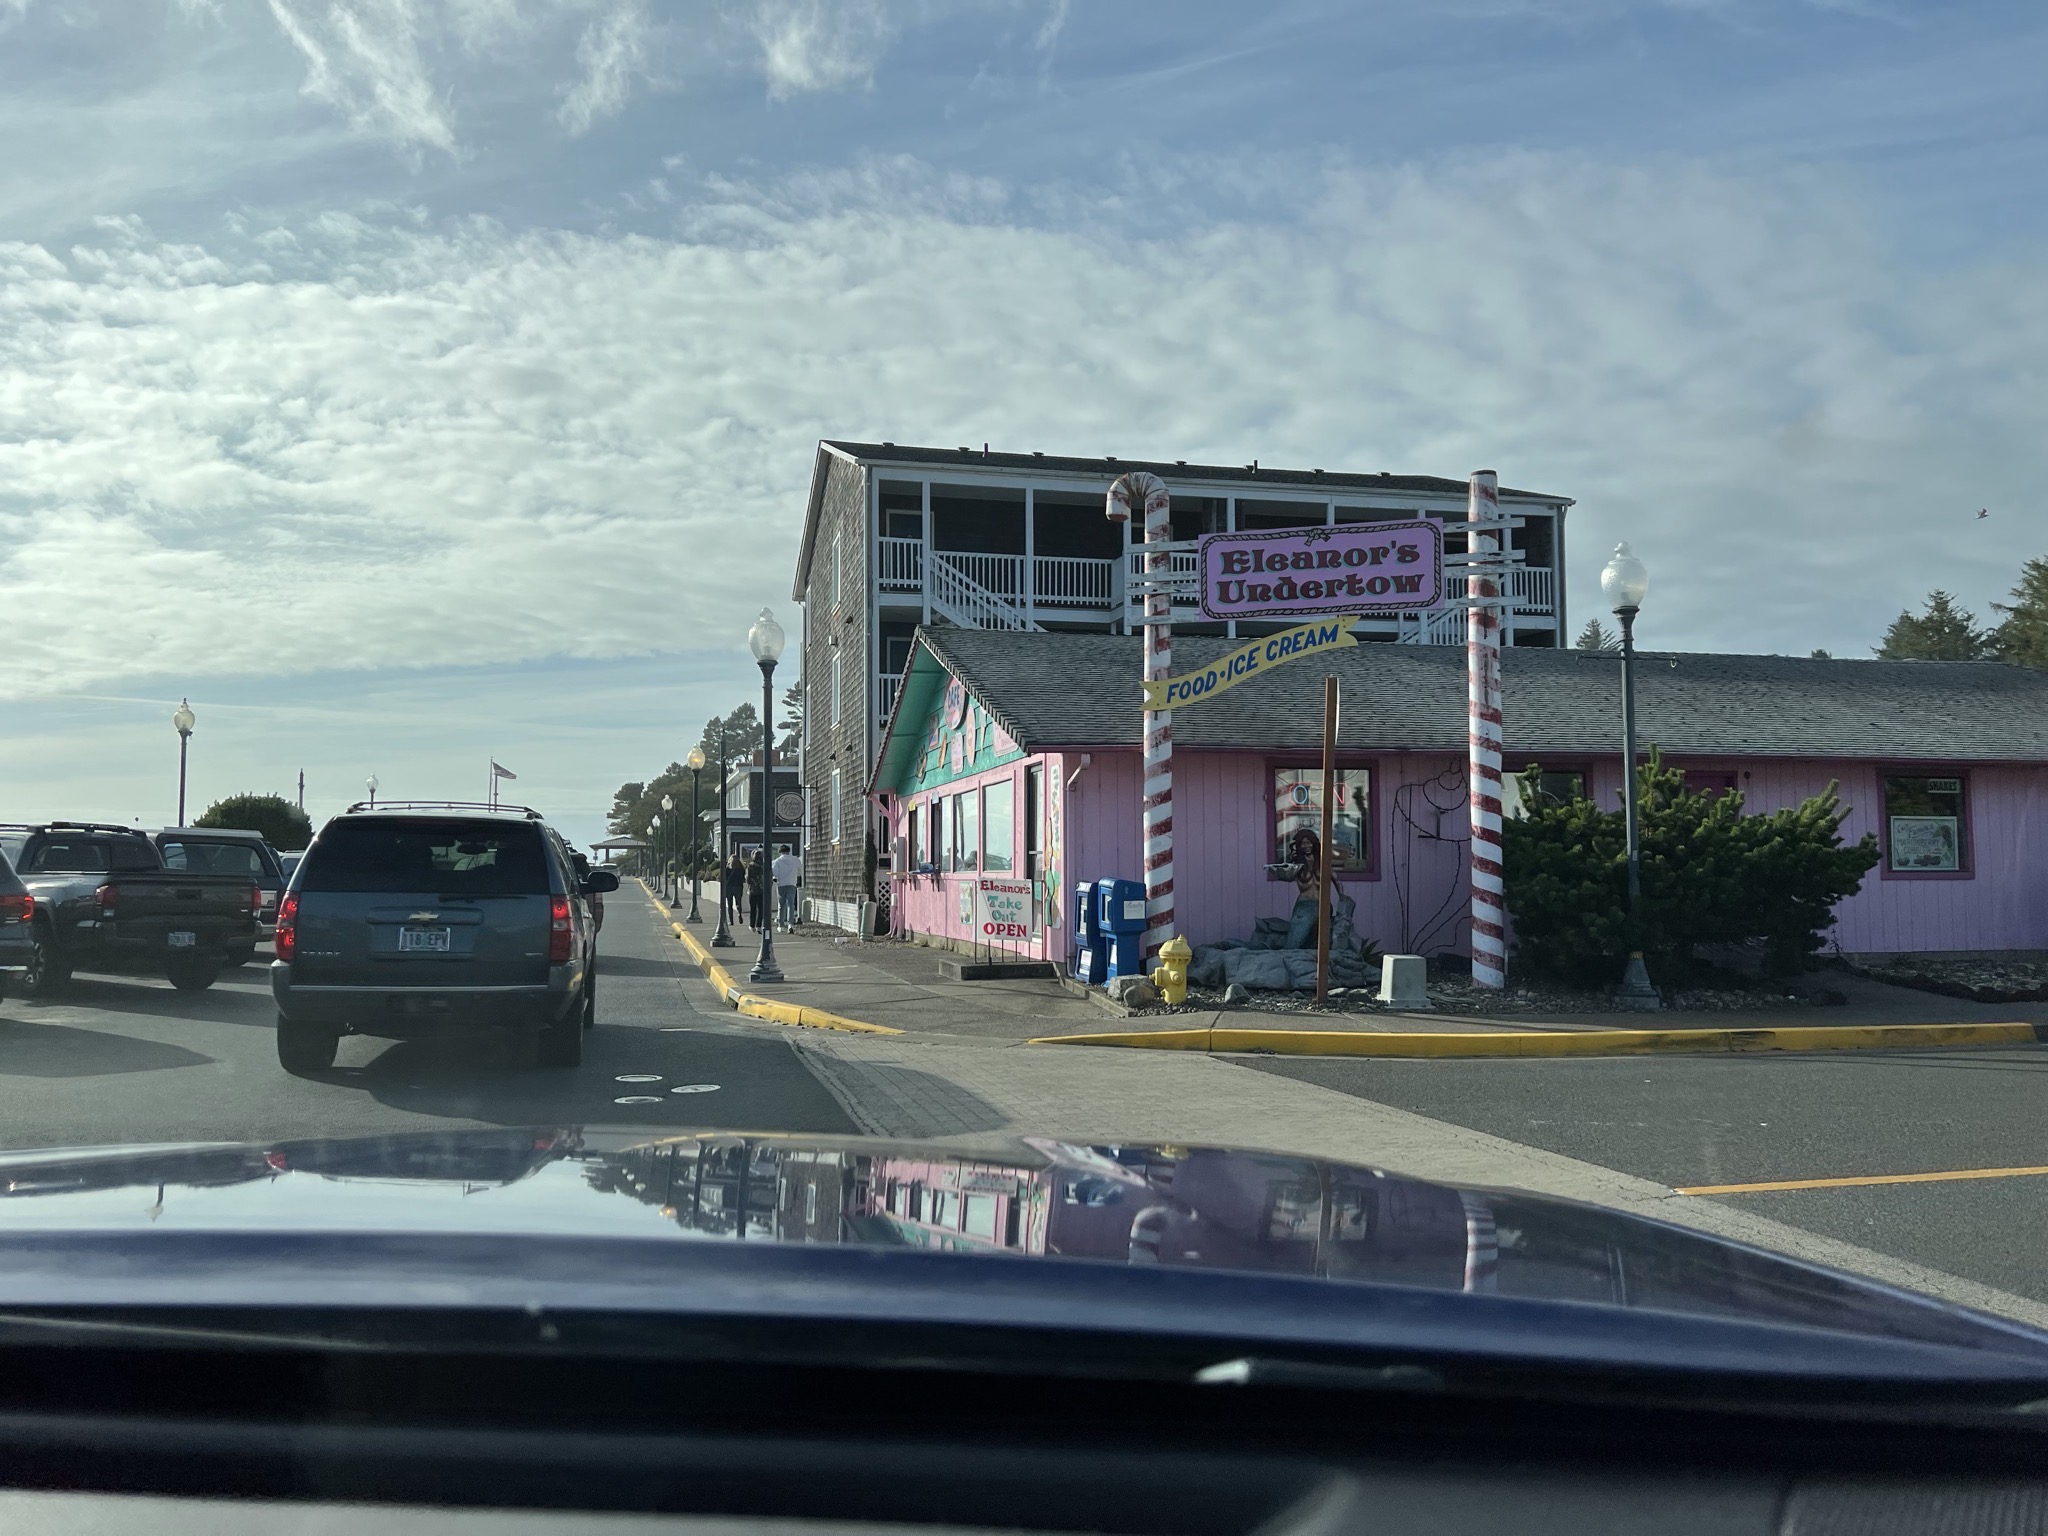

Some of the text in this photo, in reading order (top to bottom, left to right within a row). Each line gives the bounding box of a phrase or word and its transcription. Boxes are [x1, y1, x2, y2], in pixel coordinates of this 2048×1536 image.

[1219, 540, 1421, 575] Eleanor's
[1216, 572, 1425, 605] Undertow
[1166, 624, 1339, 704] FOOD ICE CREAM
[1928, 780, 1957, 792] SHAKES
[1293, 784, 1345, 806] OPN
[980, 880, 1031, 895] Eleanor's
[988, 895, 1023, 910] Take
[992, 910, 1017, 923] Out
[983, 922, 1027, 938] OPEN
[428, 933, 448, 946] EPV
